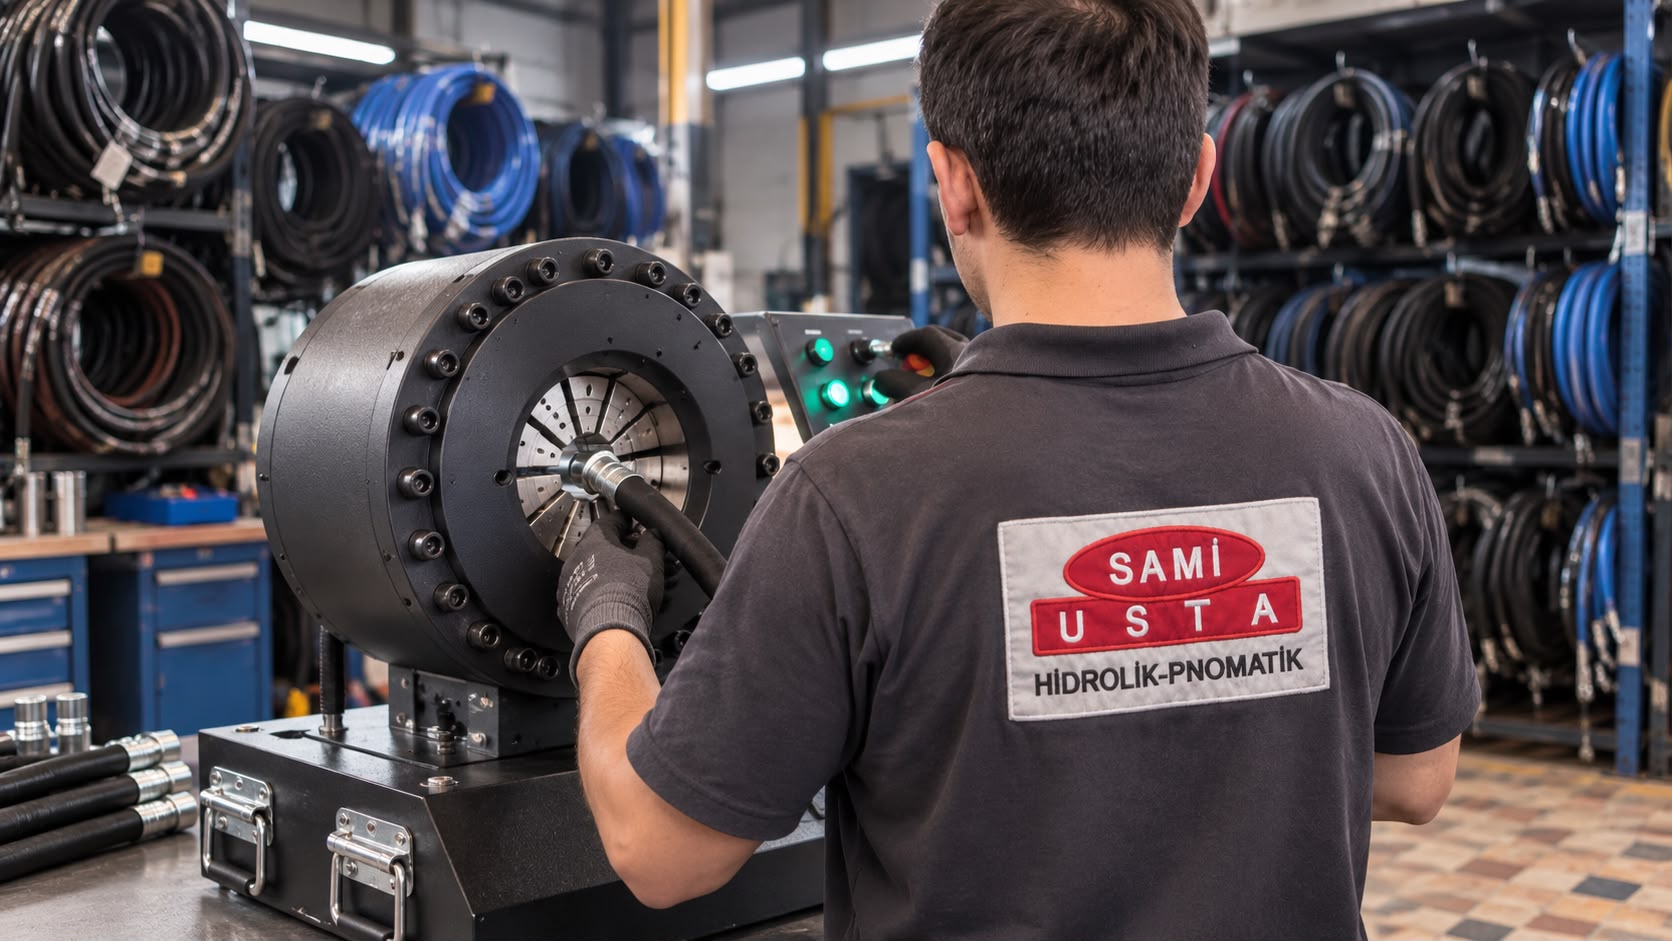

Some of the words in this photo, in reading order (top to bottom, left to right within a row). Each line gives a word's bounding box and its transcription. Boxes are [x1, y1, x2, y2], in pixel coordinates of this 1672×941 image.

[1109, 537, 1221, 585] SAMİ
[1059, 593, 1279, 643] USTA
[1034, 645, 1304, 696] HİDROLİK-PNOMATİK
